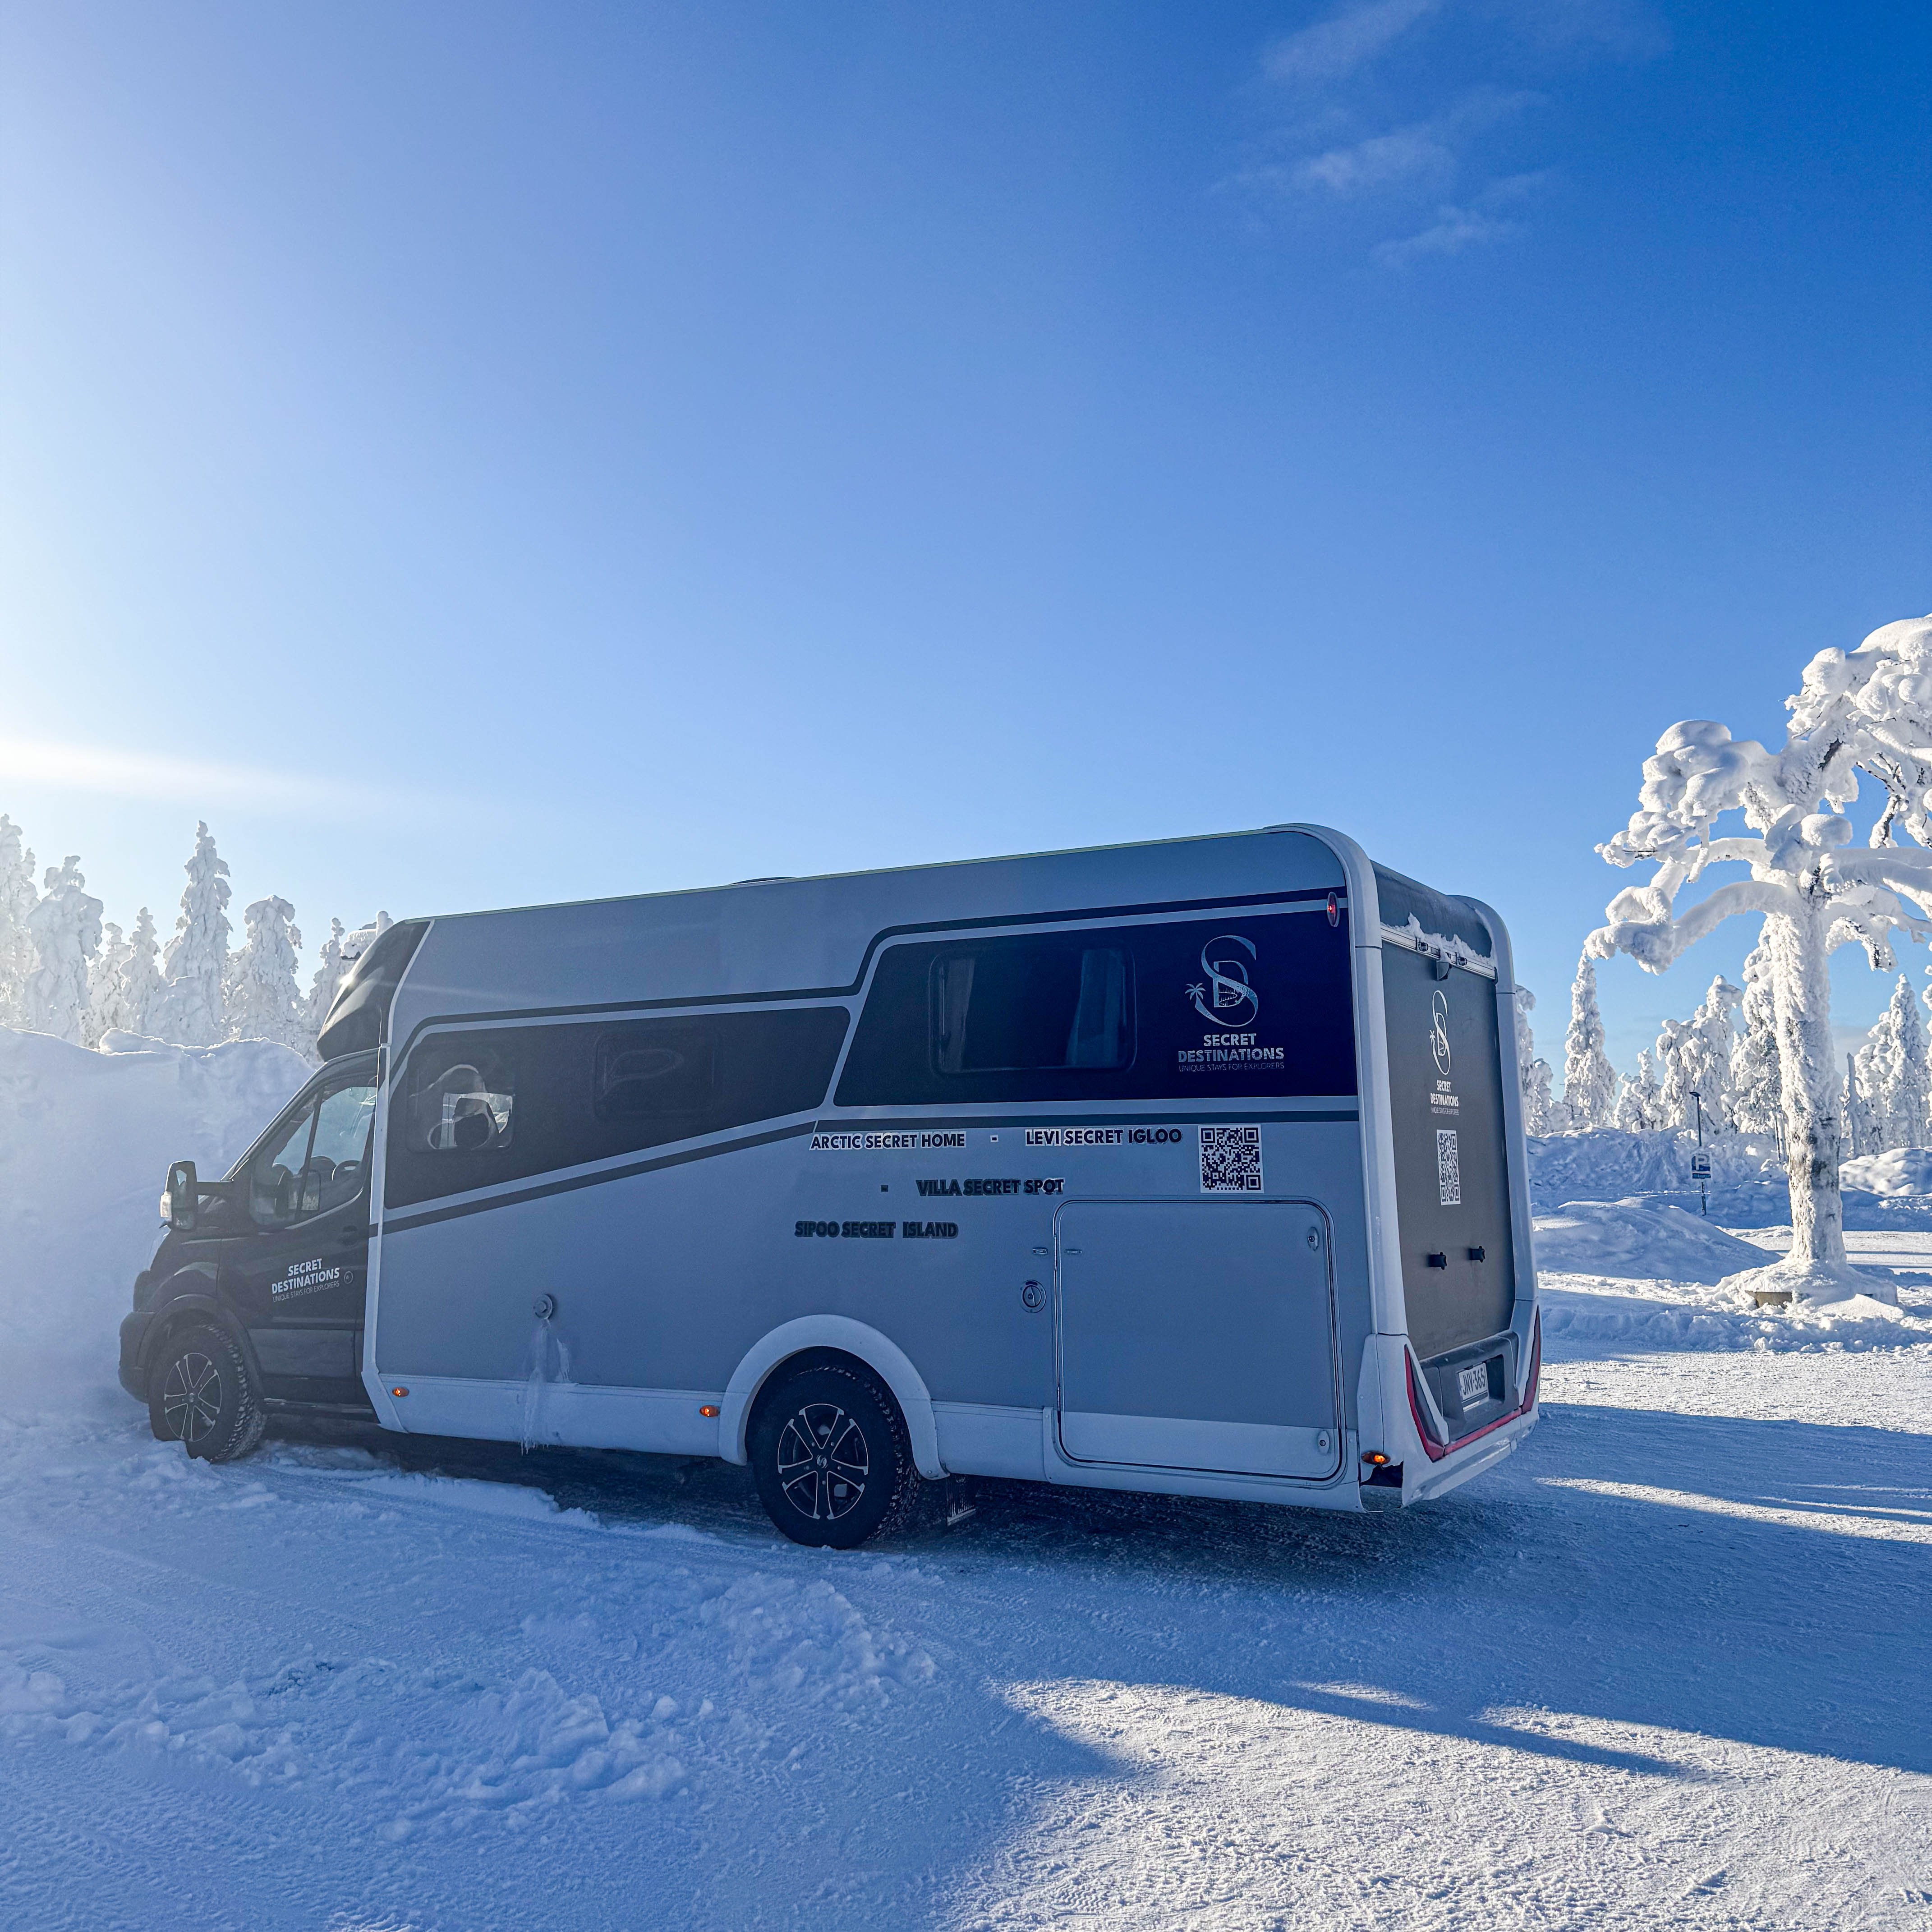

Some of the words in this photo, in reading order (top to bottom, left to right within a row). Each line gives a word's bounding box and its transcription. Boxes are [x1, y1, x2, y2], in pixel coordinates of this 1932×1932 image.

[1204, 1033, 1256, 1046] SECRET
[1178, 1048, 1284, 1062] DESTINATIONS
[1437, 1080, 1451, 1092] SECRET
[810, 1136, 861, 1149] ARCTIC
[865, 1134, 917, 1148] SECRET
[921, 1133, 965, 1147] HOME
[1026, 1130, 1060, 1145] LEVI
[1065, 1129, 1123, 1144] SECRET
[1129, 1128, 1182, 1143] IGLOO
[916, 1180, 961, 1196] VILLA
[963, 1179, 1021, 1195] SECRET
[1024, 1179, 1064, 1194] SPOT
[795, 1221, 839, 1237] SIPOO
[842, 1221, 896, 1238] SECRET
[903, 1222, 958, 1238] ISLAND
[288, 1258, 322, 1276] SECRET
[271, 1268, 340, 1294] DESTINATIONS
[291, 1289, 303, 1298] STAYS
